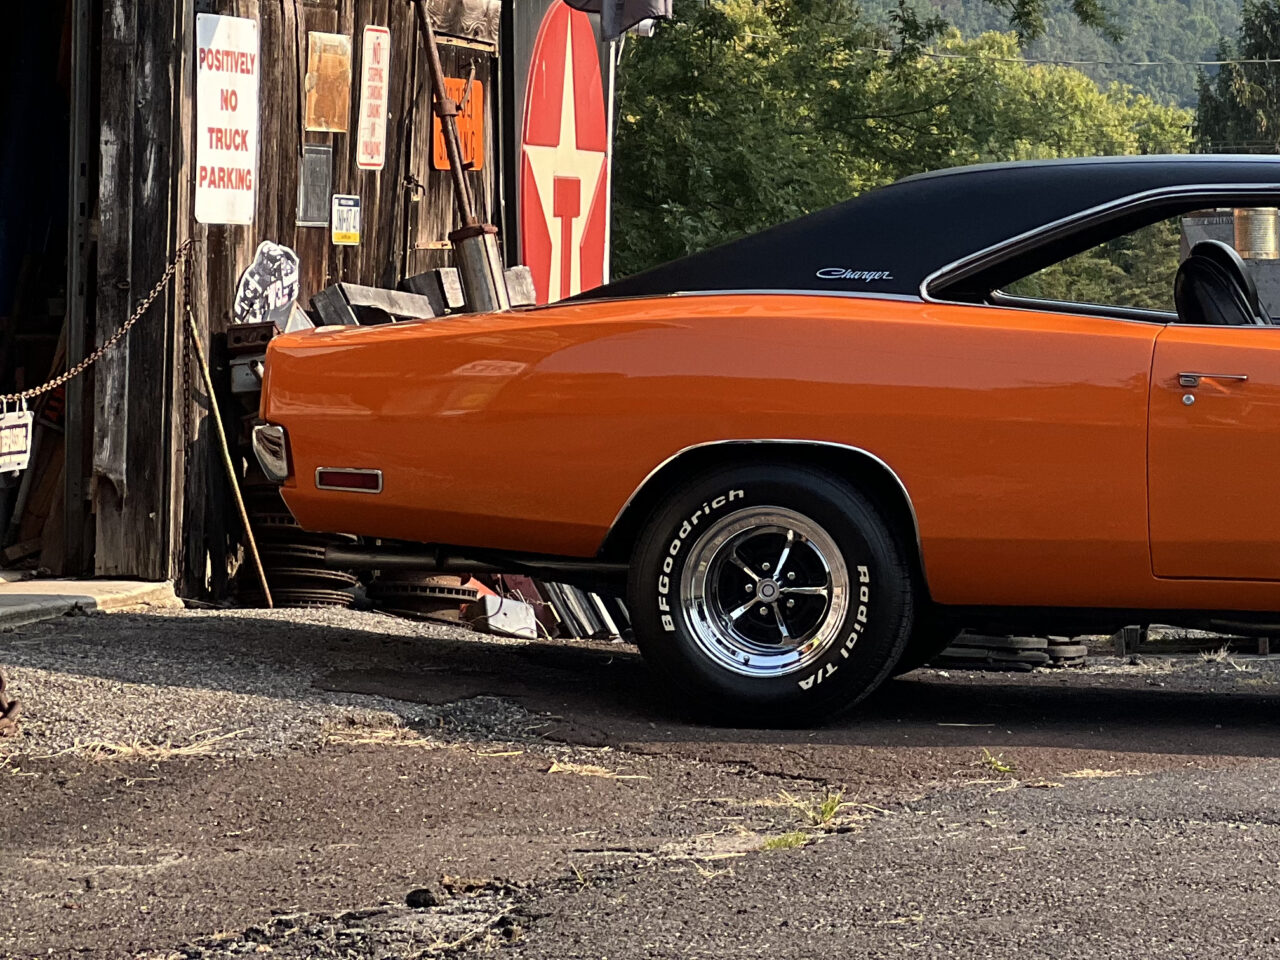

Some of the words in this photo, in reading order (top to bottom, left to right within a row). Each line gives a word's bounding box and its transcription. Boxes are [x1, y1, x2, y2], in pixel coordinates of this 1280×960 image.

[199, 47, 256, 75] POSITIVELY
[220, 88, 239, 112] NO
[207, 127, 249, 152] TRUCK
[199, 165, 252, 191] PARKING
[815, 267, 894, 283] Charger
[658, 489, 744, 632] BFGoodrich
[839, 564, 870, 658] Radial
[798, 662, 839, 690] T/A
